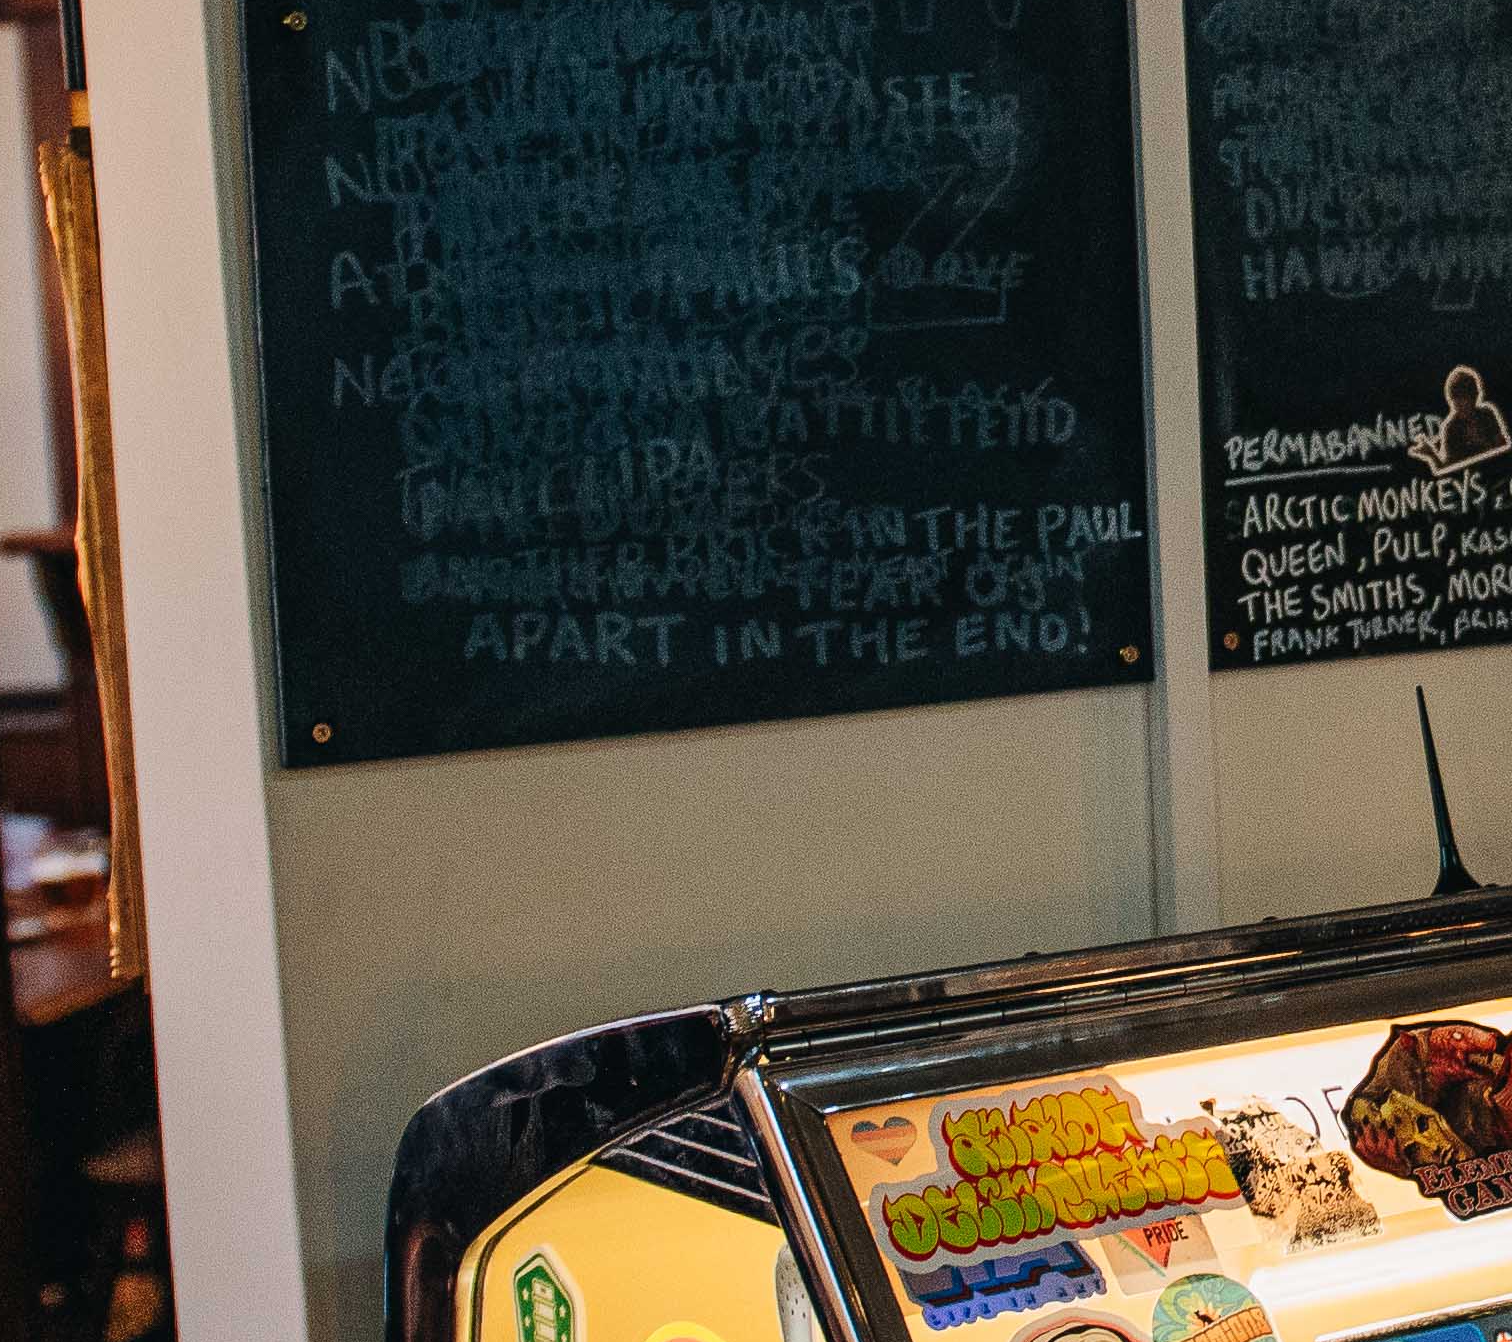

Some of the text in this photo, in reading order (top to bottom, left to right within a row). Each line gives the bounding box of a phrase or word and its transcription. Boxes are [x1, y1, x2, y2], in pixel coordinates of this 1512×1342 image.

[915, 500, 1143, 556] THE PAUL
[1240, 493, 1346, 539] ARCTIC
[1238, 587, 1302, 625] THE
[463, 607, 1092, 668] APART IN THE END!
[1253, 627, 1339, 660] FRANK
[1143, 1220, 1189, 1247] PRIDE
